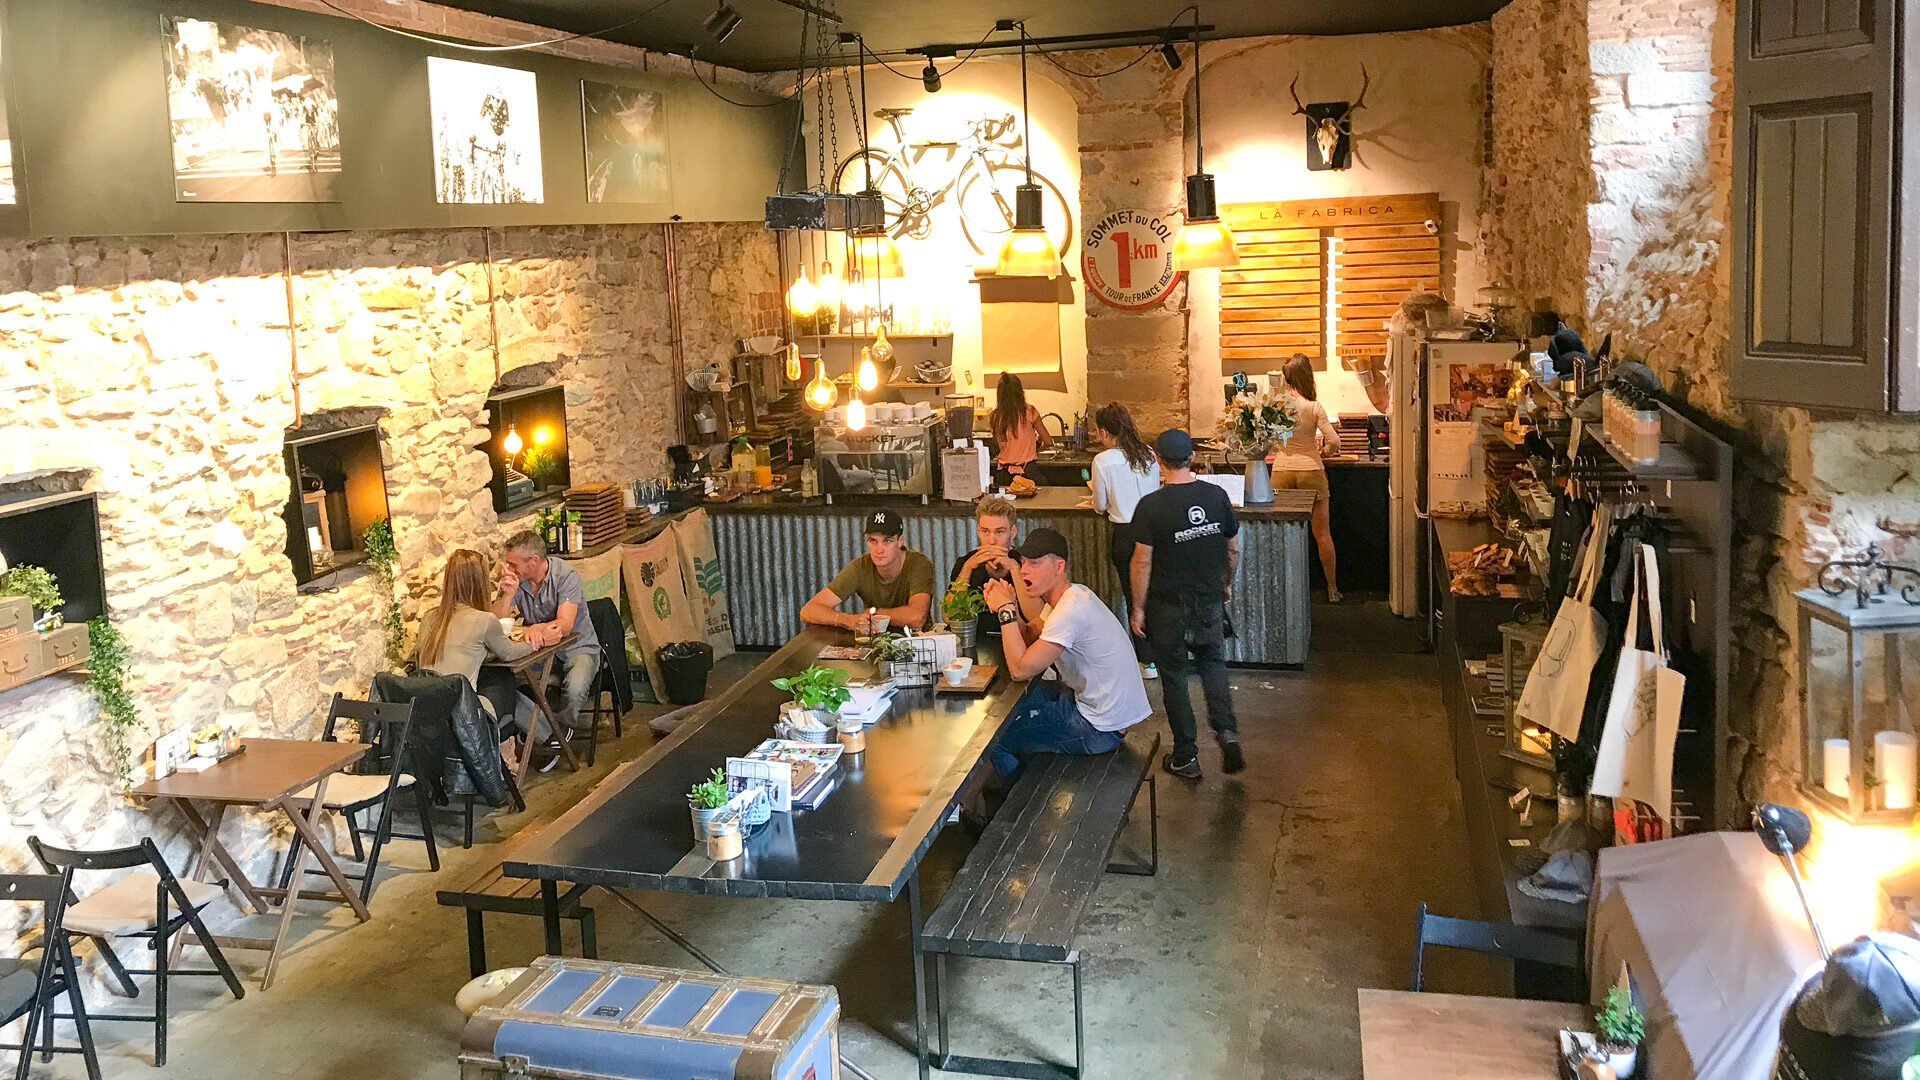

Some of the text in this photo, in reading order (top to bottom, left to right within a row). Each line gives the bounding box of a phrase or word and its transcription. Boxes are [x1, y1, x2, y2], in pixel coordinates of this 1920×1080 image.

[1086, 210, 1172, 248] SOMMET DU COL
[1110, 231, 1132, 289] 1
[1133, 237, 1158, 260] km
[1105, 286, 1125, 301] TOUR
[1132, 284, 1161, 302] FRANCE
[874, 512, 886, 524] NY
[1174, 522, 1221, 539] ROCKET
